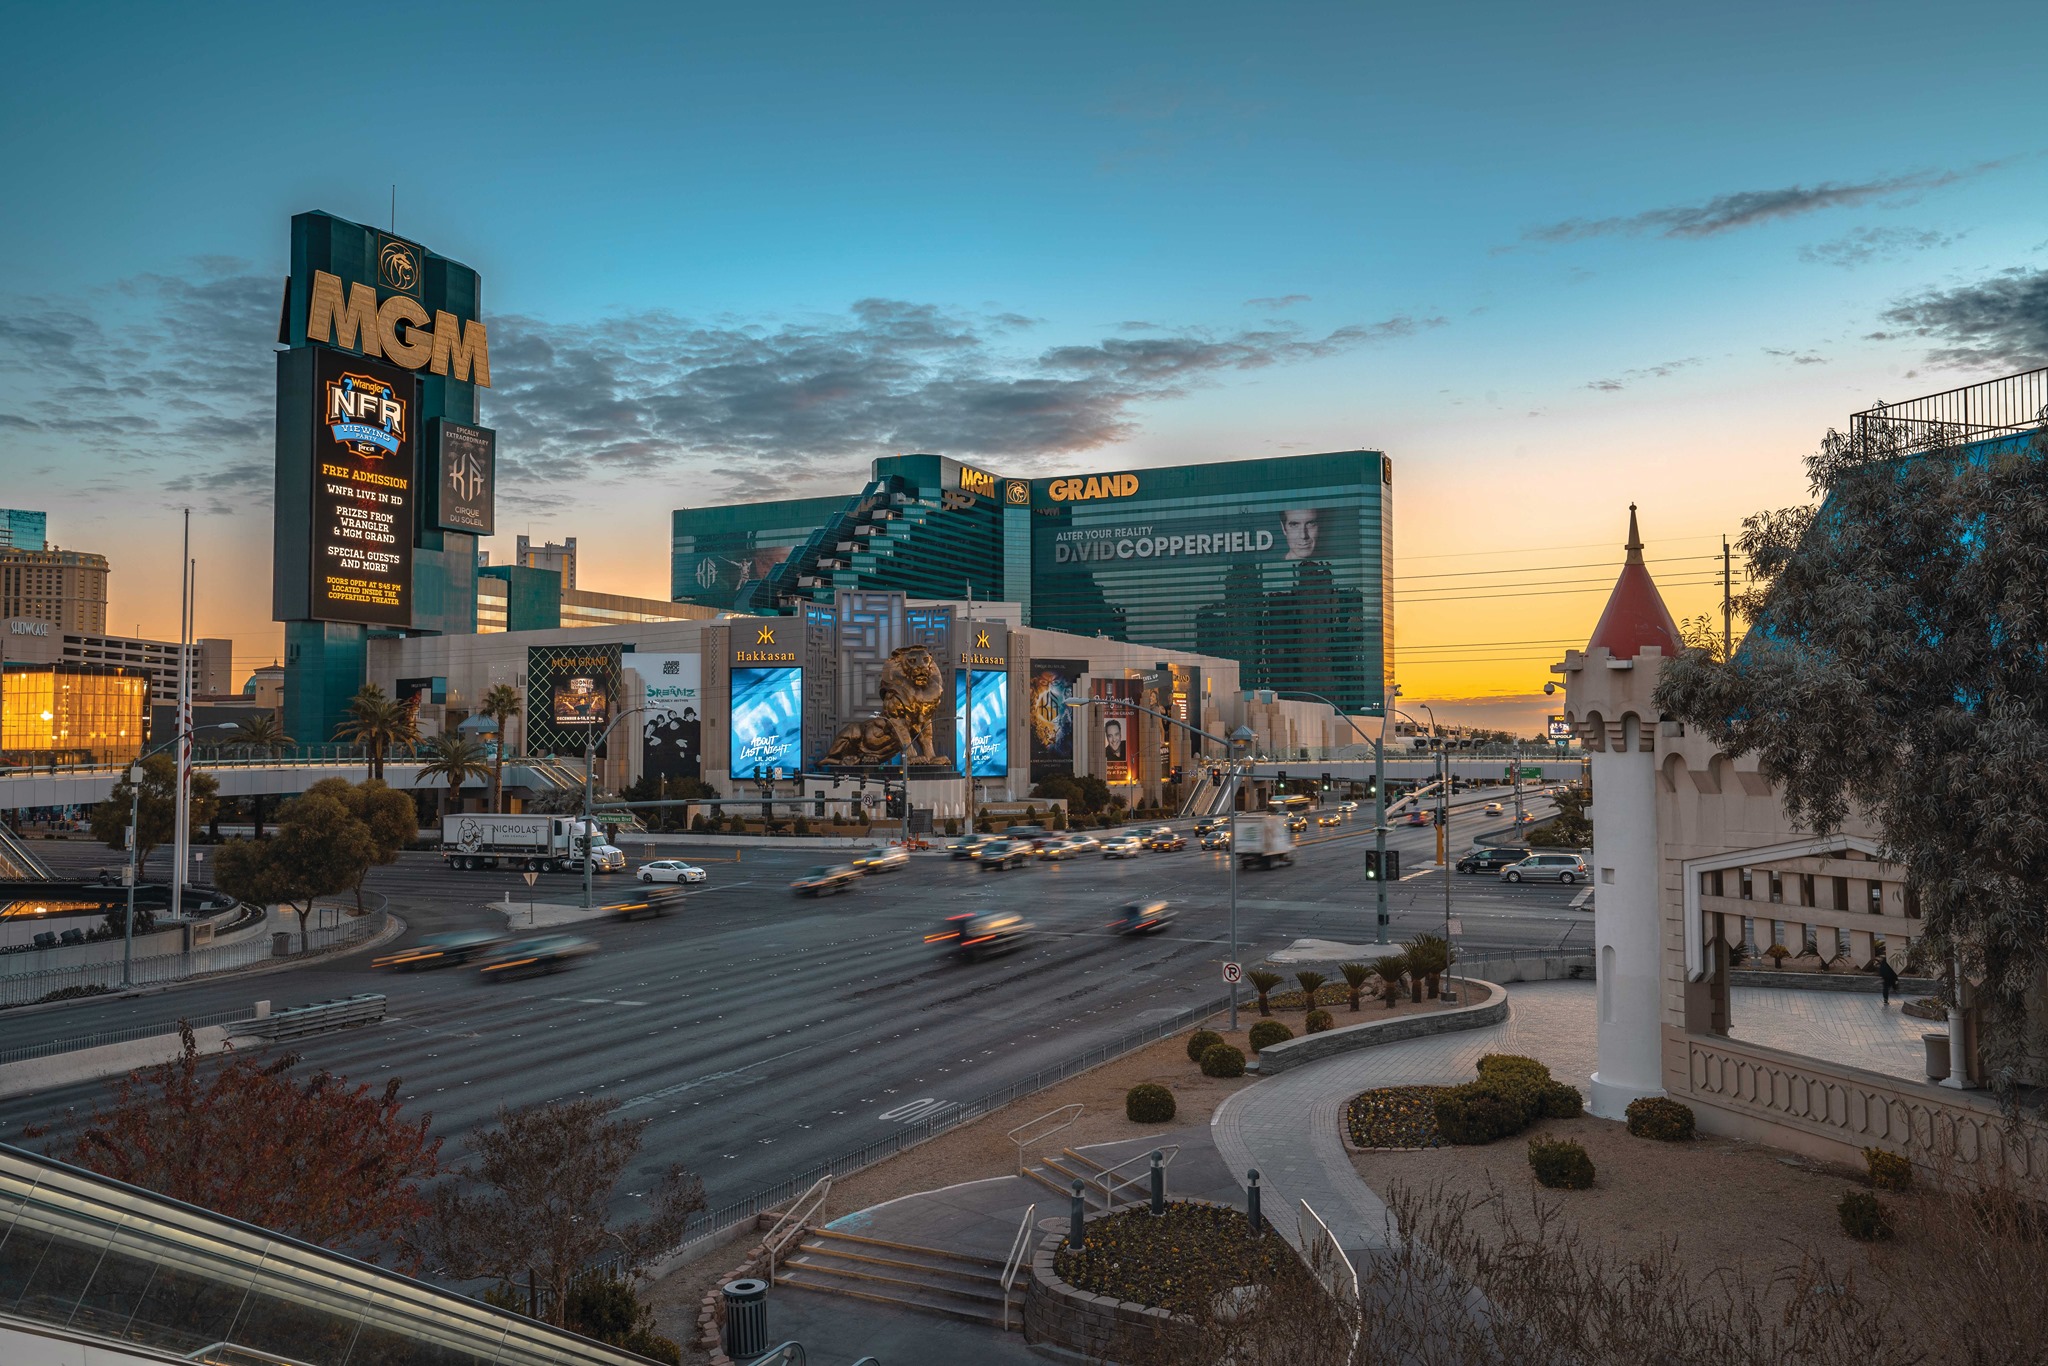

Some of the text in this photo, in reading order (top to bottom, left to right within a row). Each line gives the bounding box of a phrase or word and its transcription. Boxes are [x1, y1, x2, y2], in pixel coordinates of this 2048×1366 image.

[307, 270, 491, 388] MGM
[351, 377, 384, 395] Wrangler
[331, 387, 402, 434] NFR
[341, 425, 391, 442] VIEWING
[355, 432, 377, 442] PARTY
[446, 431, 489, 446] EXTRAORDINARY
[456, 426, 479, 437] EPICALLY
[322, 464, 408, 490] FREE ADMISSION
[960, 466, 1139, 502] MGM GRAND
[326, 483, 403, 506] WNFR LIVE IN HD
[336, 505, 394, 524] PRIZES FROM
[455, 505, 480, 518] CIRQUE
[340, 516, 390, 533] WRANGLER
[450, 514, 484, 527] DU SOLEIL
[333, 526, 395, 544] & MGM GRAND
[1055, 526, 1154, 542] ALTER YOUR REALITY
[327, 546, 400, 564] SPECIAL GUESTS
[340, 558, 389, 573] AND MORE!
[326, 576, 349, 585] DOORS
[350, 579, 367, 587] OPEN
[368, 581, 377, 589] AT
[391, 584, 402, 592] PM
[332, 585, 397, 598] LOCATED INSIDE THE
[328, 591, 400, 606] COPPERFIELD THEATER
[11, 621, 49, 637] SHOWCASE
[551, 656, 609, 667] MGM GRAND
[736, 651, 796, 662] Hakkasan
[750, 735, 779, 747] ABOUT
[740, 745, 764, 760] LAST
[493, 824, 537, 834] NICHOLAS
